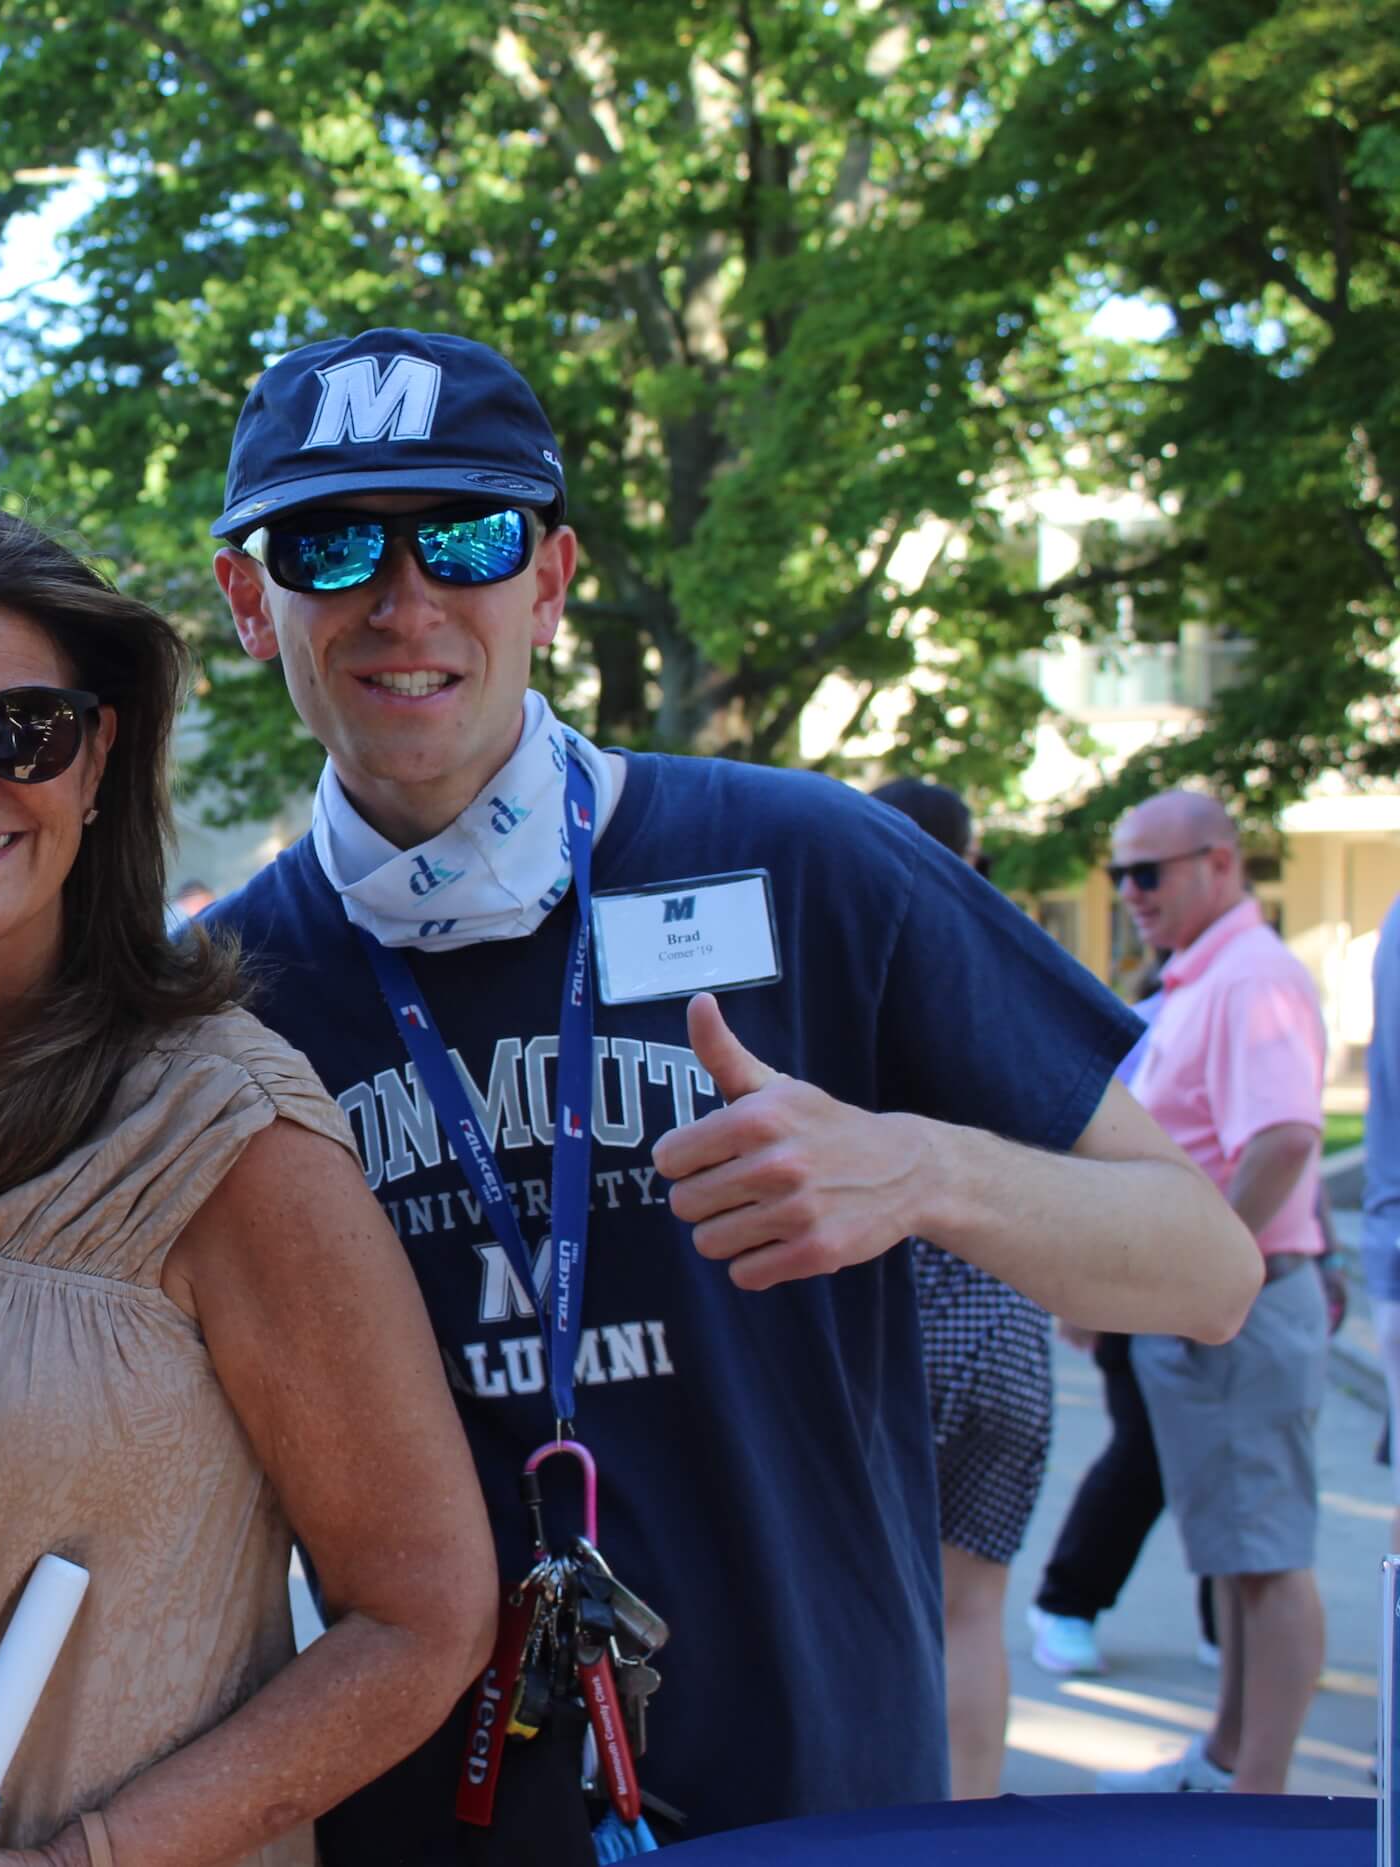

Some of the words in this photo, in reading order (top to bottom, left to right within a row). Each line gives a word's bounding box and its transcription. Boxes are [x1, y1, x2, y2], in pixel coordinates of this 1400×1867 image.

[301, 354, 442, 450] M
[662, 895, 696, 923] M
[667, 930, 700, 945] Brad
[460, 1119, 503, 1202] FALKEN
[557, 1239, 571, 1333] FALKEN
[463, 1320, 676, 1398] LUMNI
[467, 1668, 503, 1785] Jeep
